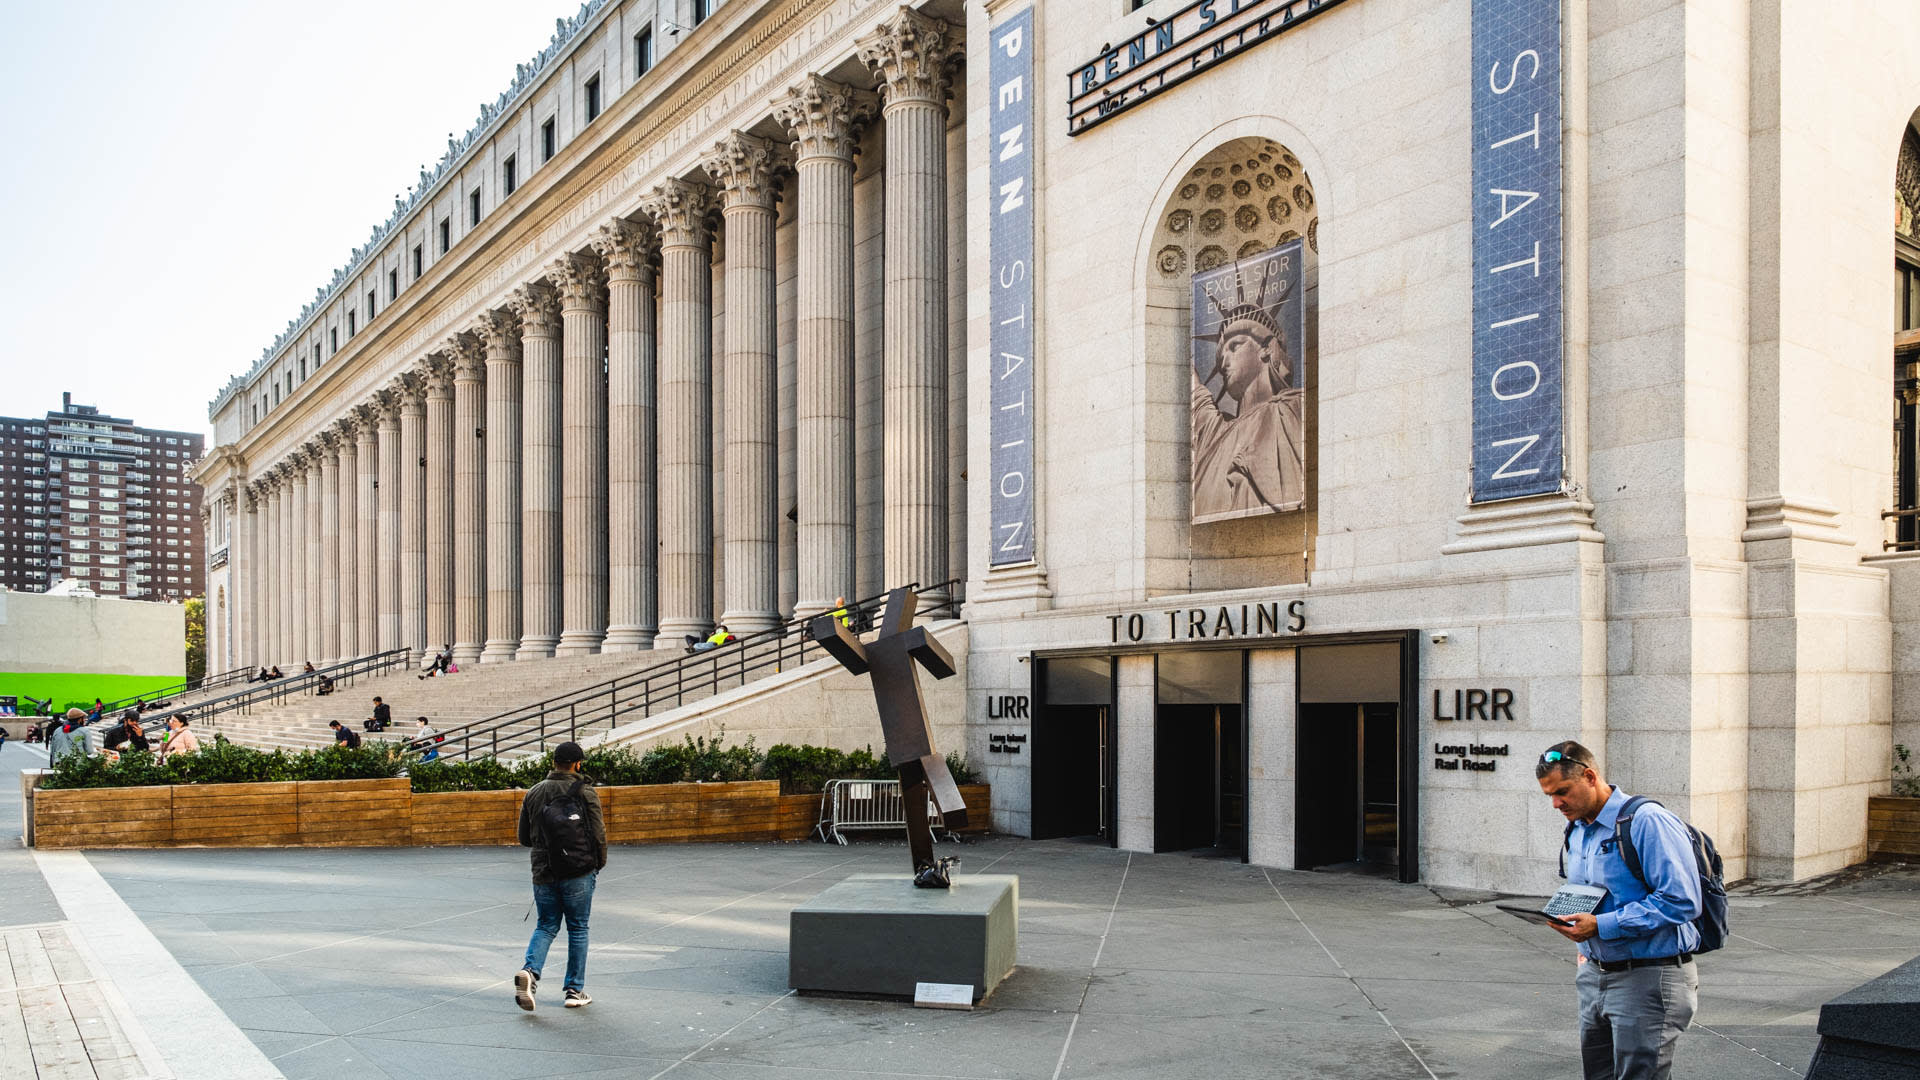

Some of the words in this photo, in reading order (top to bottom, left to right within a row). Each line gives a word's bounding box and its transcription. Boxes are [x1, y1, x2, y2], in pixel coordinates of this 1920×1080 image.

[1081, 20, 1174, 95] PENN
[547, 169, 629, 243] COMPLETION
[638, 149, 654, 176] OF
[662, 104, 711, 157] THEIR
[720, 12, 833, 113] APPOINTED
[999, 25, 1024, 215] PENN
[1205, 256, 1290, 297] EXCELSIOR
[1490, 49, 1540, 480] STATION
[1207, 296, 1235, 314] EVER
[999, 260, 1026, 553] STATION
[1106, 613, 1144, 643] TO
[1164, 600, 1306, 640] TRAINS
[989, 695, 1029, 719] LIRR
[1433, 688, 1514, 721] LIRR
[1435, 743, 1467, 758] Long
[1469, 743, 1509, 756] Island
[1435, 758, 1459, 771] Rail
[1462, 759, 1496, 772] Road
